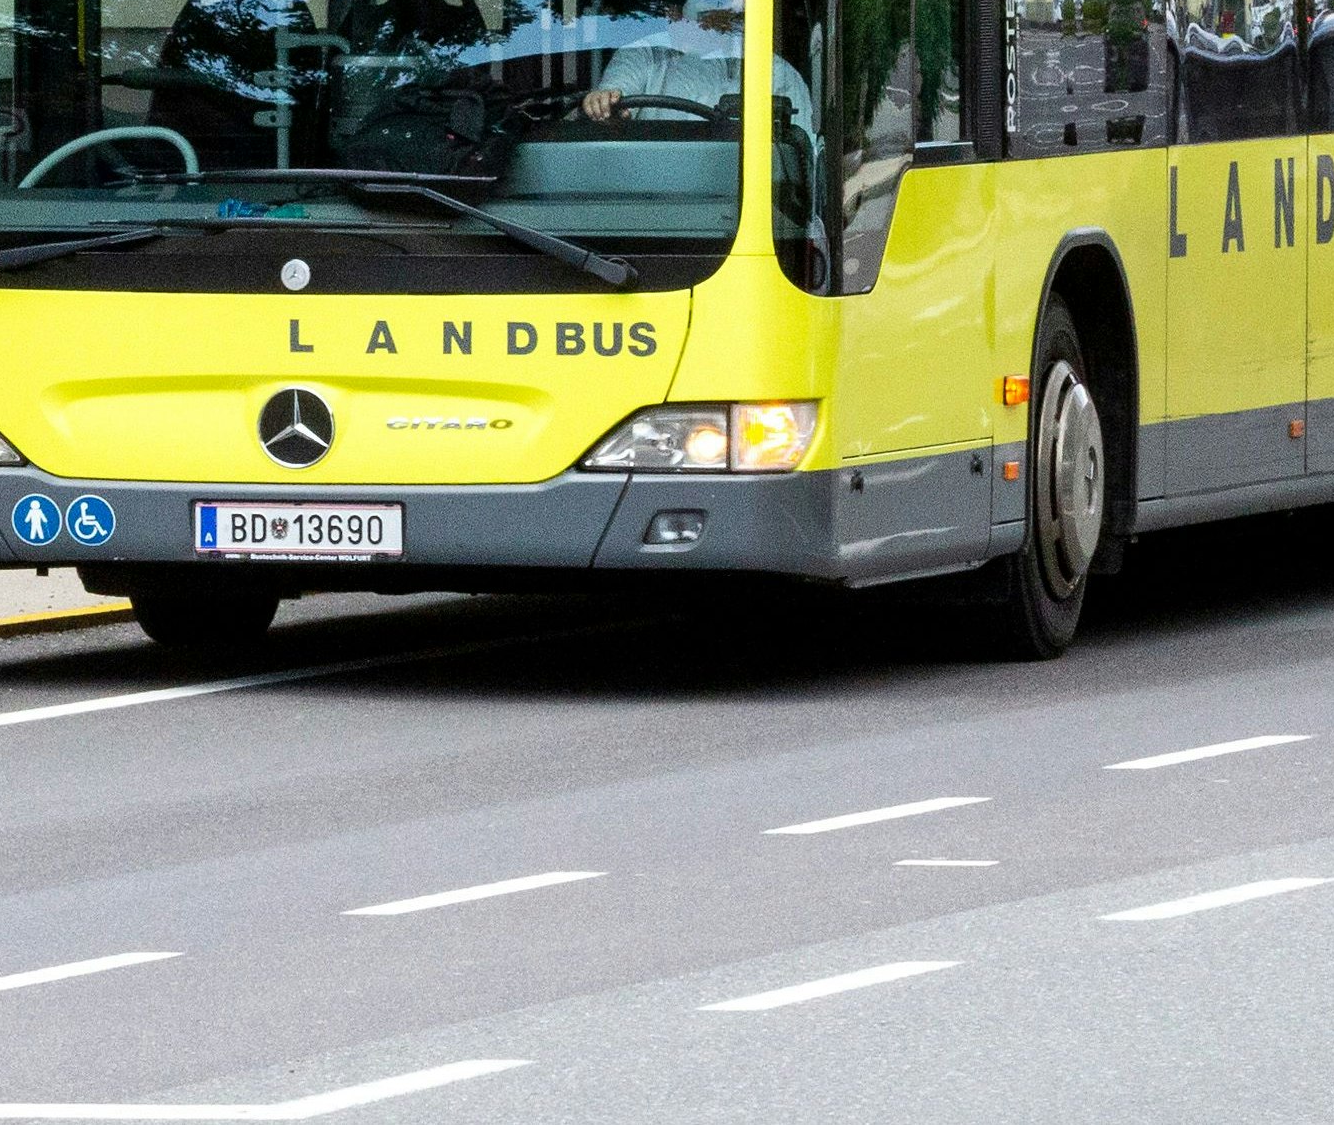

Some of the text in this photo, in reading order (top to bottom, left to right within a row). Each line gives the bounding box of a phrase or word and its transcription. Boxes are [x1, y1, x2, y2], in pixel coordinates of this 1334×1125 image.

[289, 319, 658, 357] LANDBUS
[385, 416, 514, 430] CITARO
[204, 532, 213, 543] A
[231, 513, 383, 545] BD 13690
